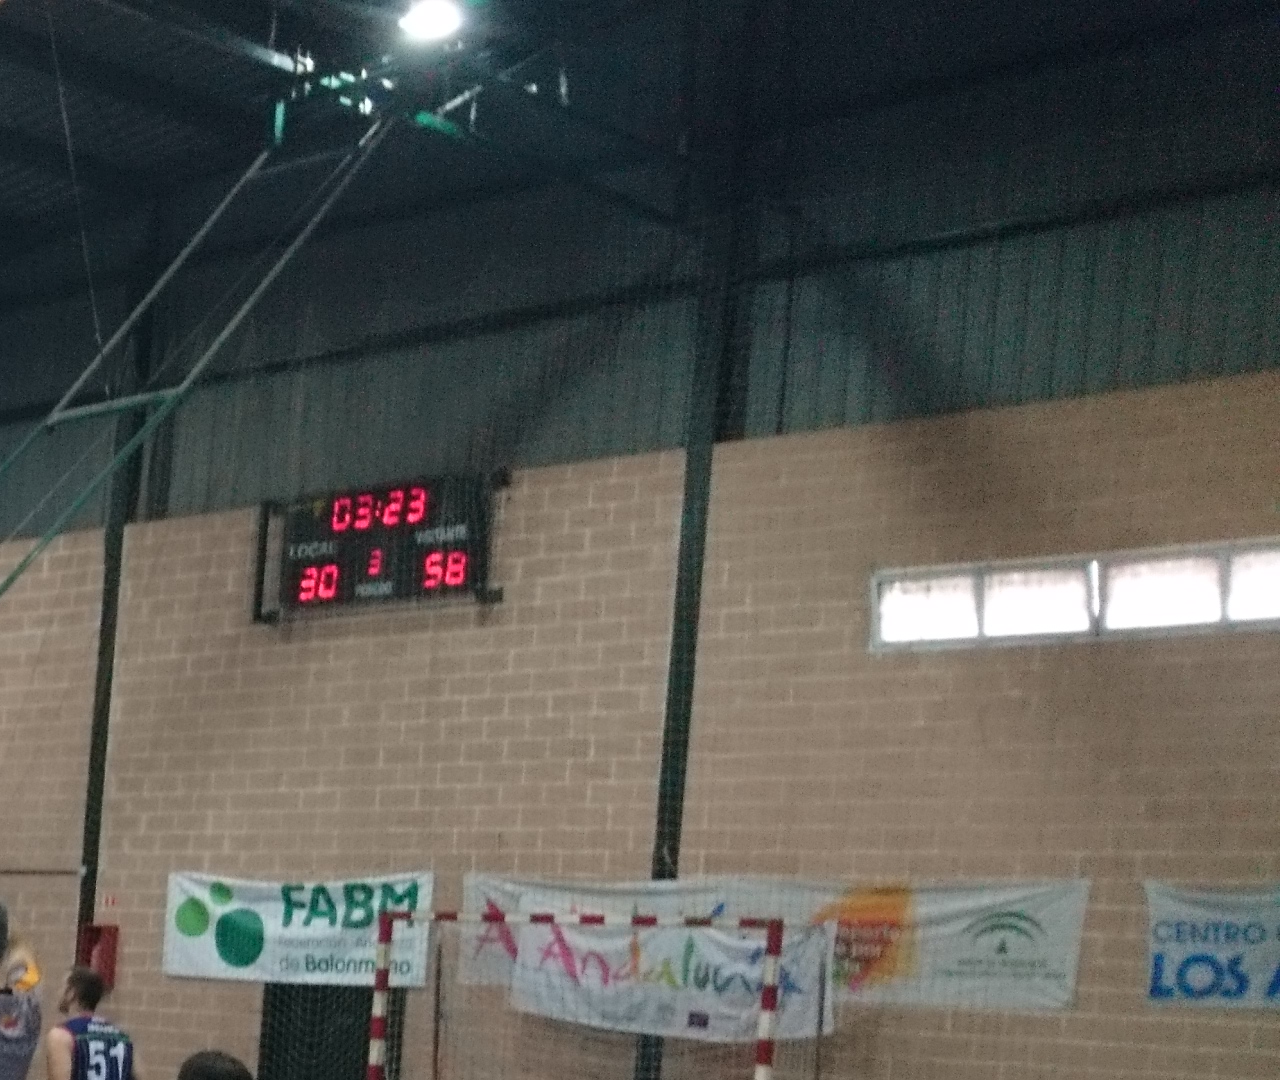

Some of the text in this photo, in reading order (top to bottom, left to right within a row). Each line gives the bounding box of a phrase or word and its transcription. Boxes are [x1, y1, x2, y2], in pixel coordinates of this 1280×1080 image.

[331, 486, 427, 532] 03:23
[289, 541, 335, 559] LOCAL
[367, 548, 383, 576] 3
[299, 564, 338, 601] 30
[422, 551, 468, 589] 58
[281, 880, 419, 929] FABM
[1152, 920, 1267, 945] CENTRO
[305, 953, 412, 975] Balonmno
[1149, 953, 1249, 999] LOS
